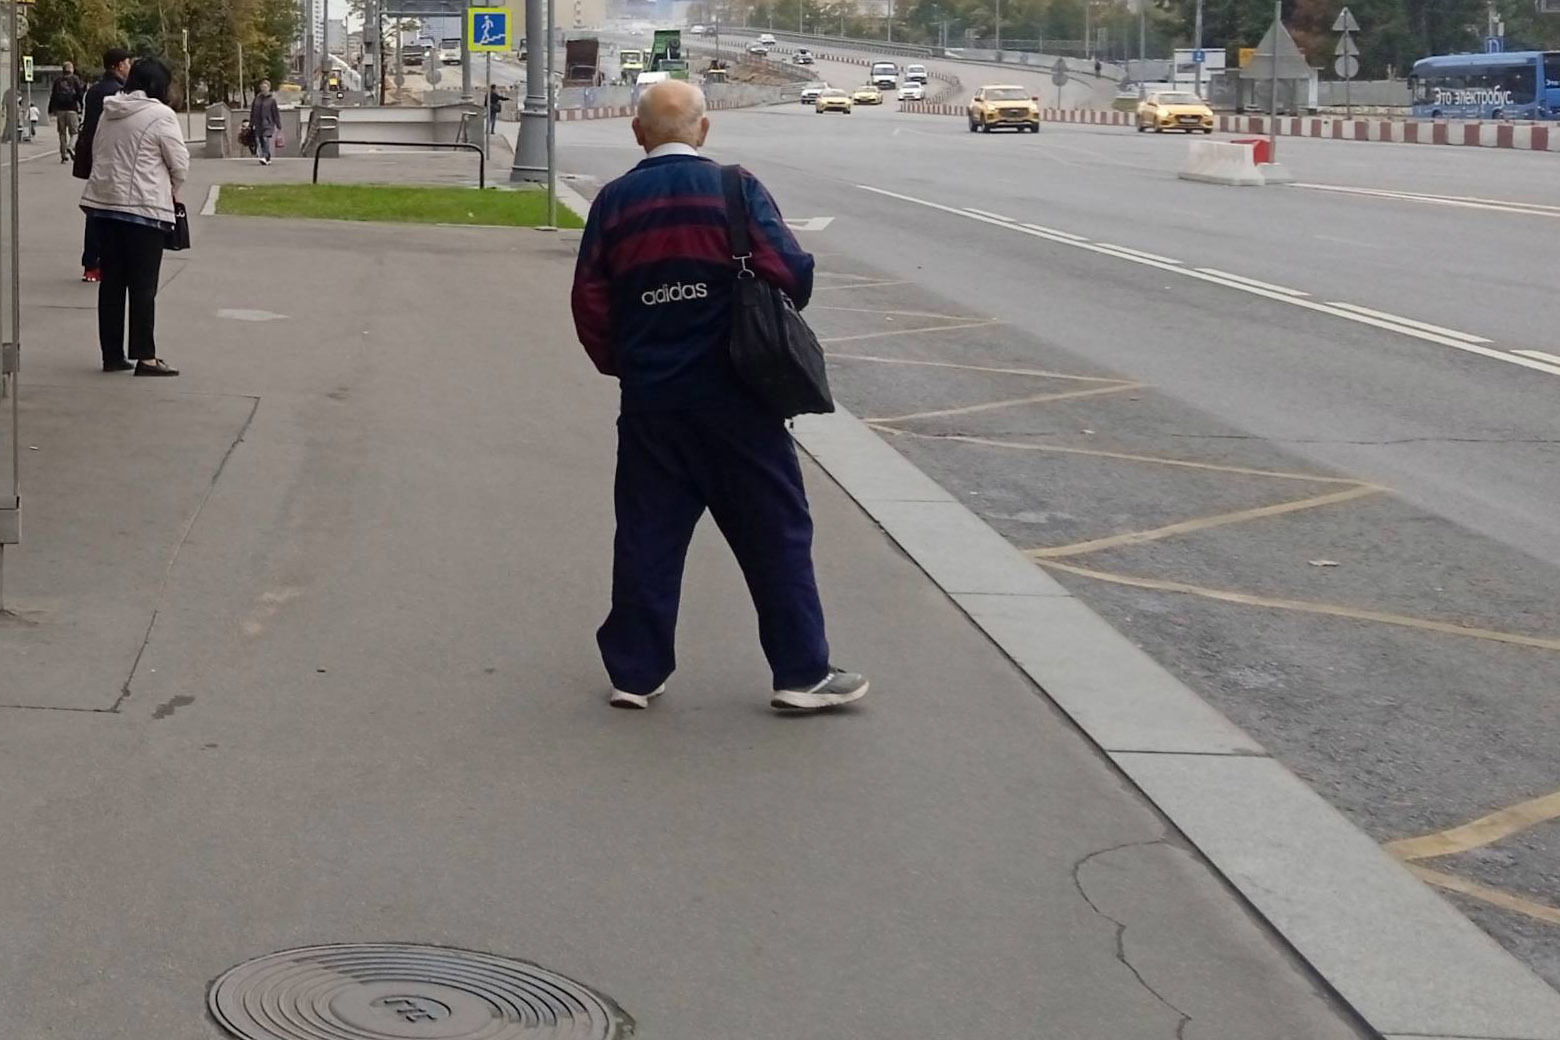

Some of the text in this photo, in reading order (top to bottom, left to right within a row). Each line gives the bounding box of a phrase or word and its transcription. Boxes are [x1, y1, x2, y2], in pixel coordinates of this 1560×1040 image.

[1433, 85, 1514, 107] Это электробус.
[641, 281, 709, 306] adidas
